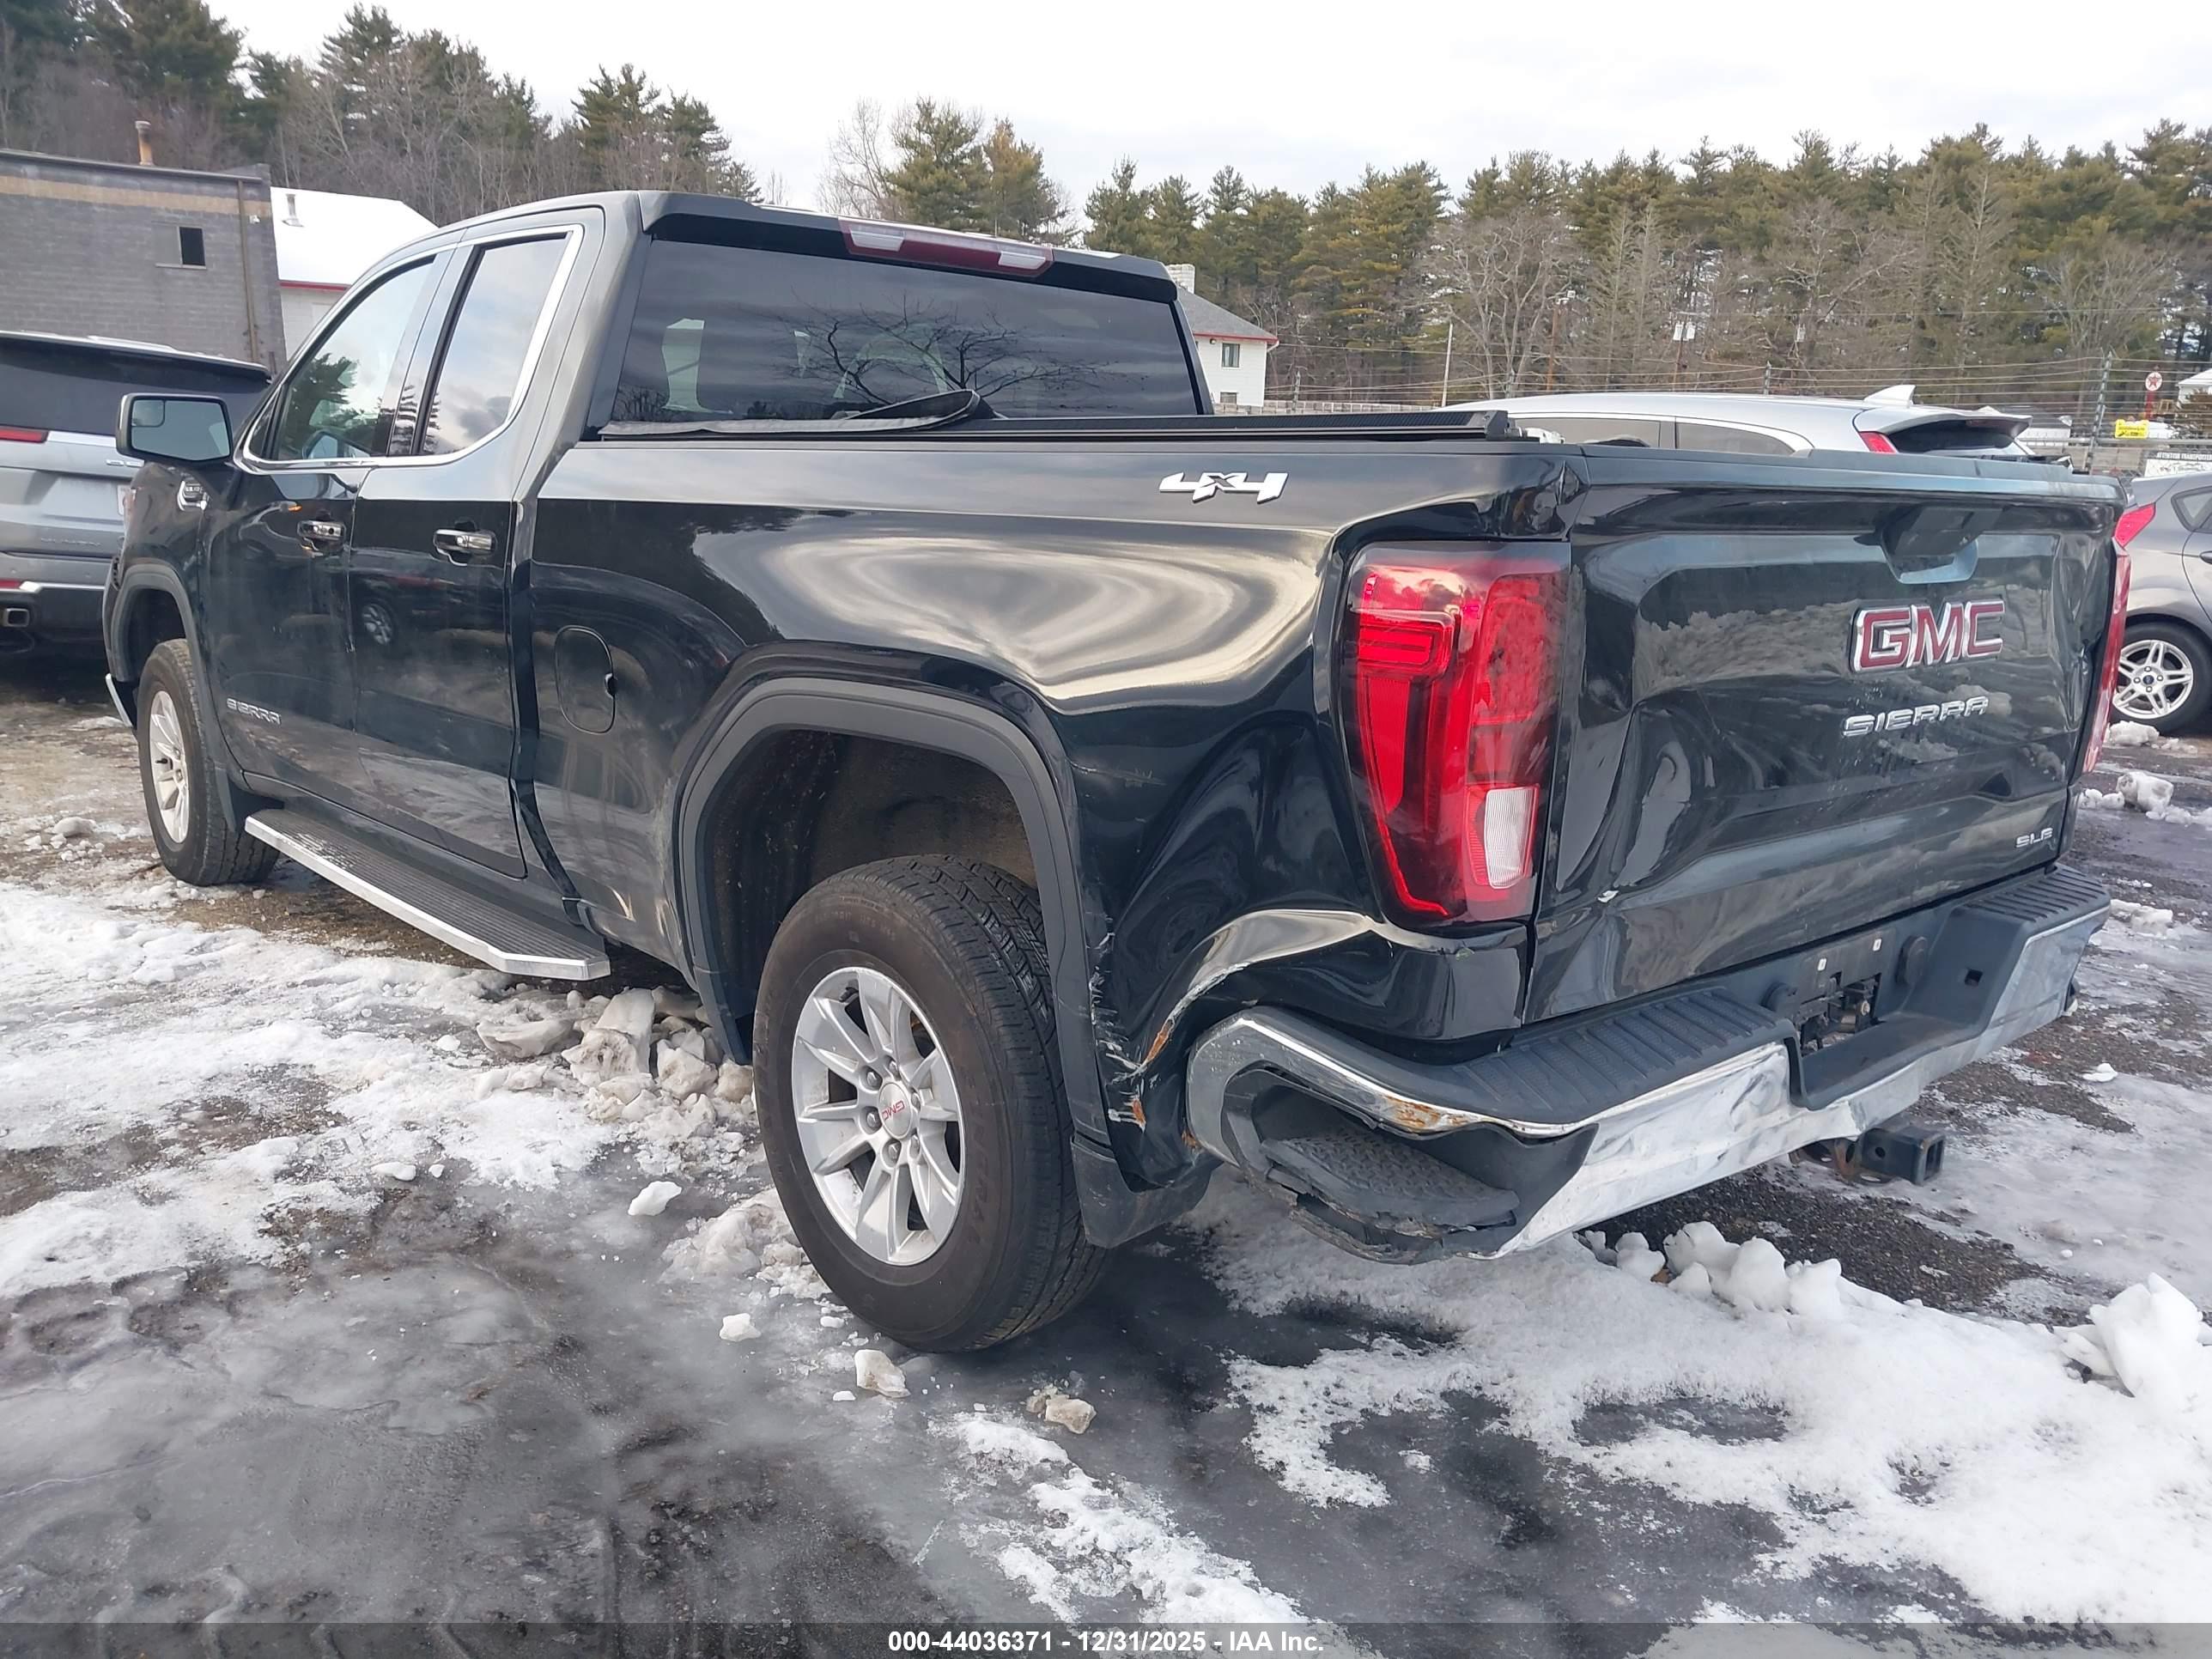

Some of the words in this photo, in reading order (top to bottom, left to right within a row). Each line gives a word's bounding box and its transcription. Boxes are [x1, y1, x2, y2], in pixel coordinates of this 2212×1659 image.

[1852, 600, 2004, 672] GMC
[227, 697, 282, 725] SIERRA
[1842, 696, 1989, 737] SIERRA
[2014, 827, 2053, 848] SLE
[882, 1100, 905, 1121] GMC
